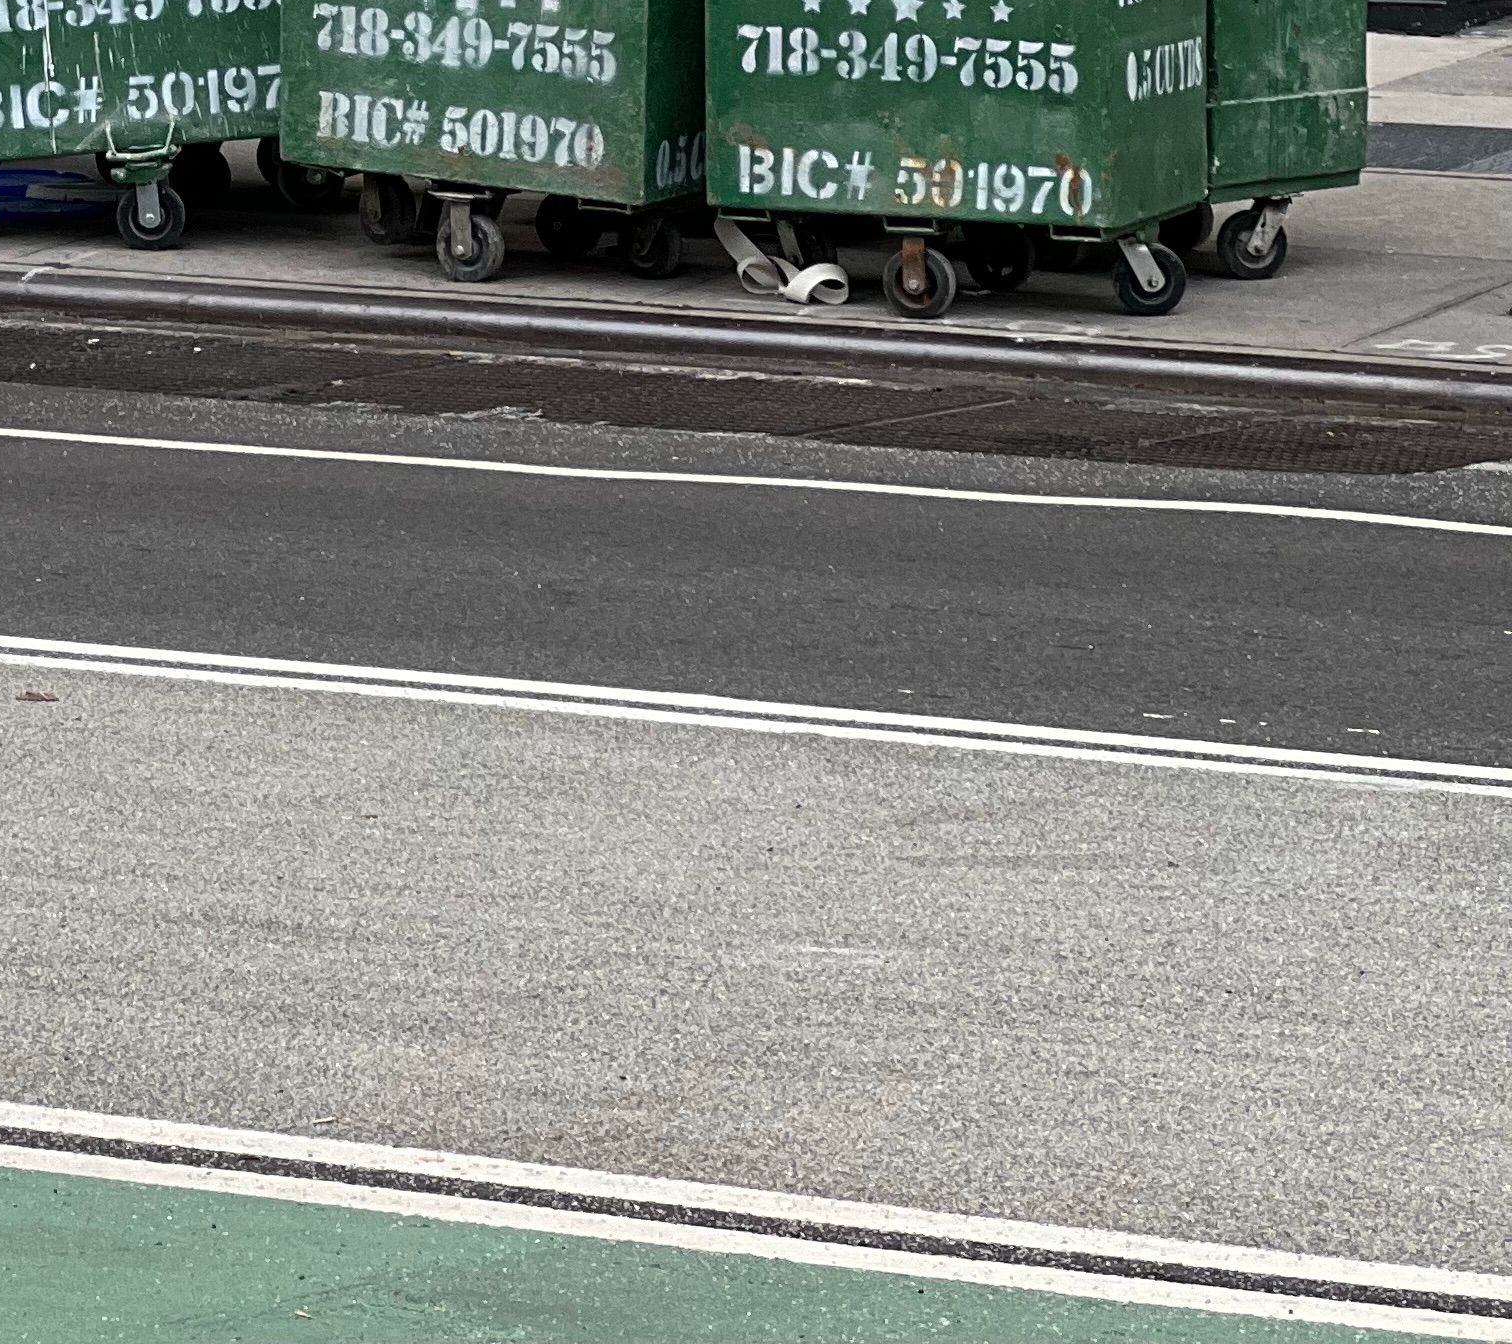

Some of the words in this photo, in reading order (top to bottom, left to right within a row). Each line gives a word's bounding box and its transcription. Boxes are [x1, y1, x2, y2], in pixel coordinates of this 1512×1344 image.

[312, 2, 617, 85] 718-349-7555
[737, 23, 1080, 96] 718-349-7555
[1154, 42, 1176, 96] CU
[1176, 34, 1203, 92] YDS
[127, 64, 281, 121] 50197
[316, 90, 430, 148] BIC#
[441, 105, 606, 170] 501970
[737, 144, 875, 201] BIC#
[893, 155, 1094, 218] 501970
